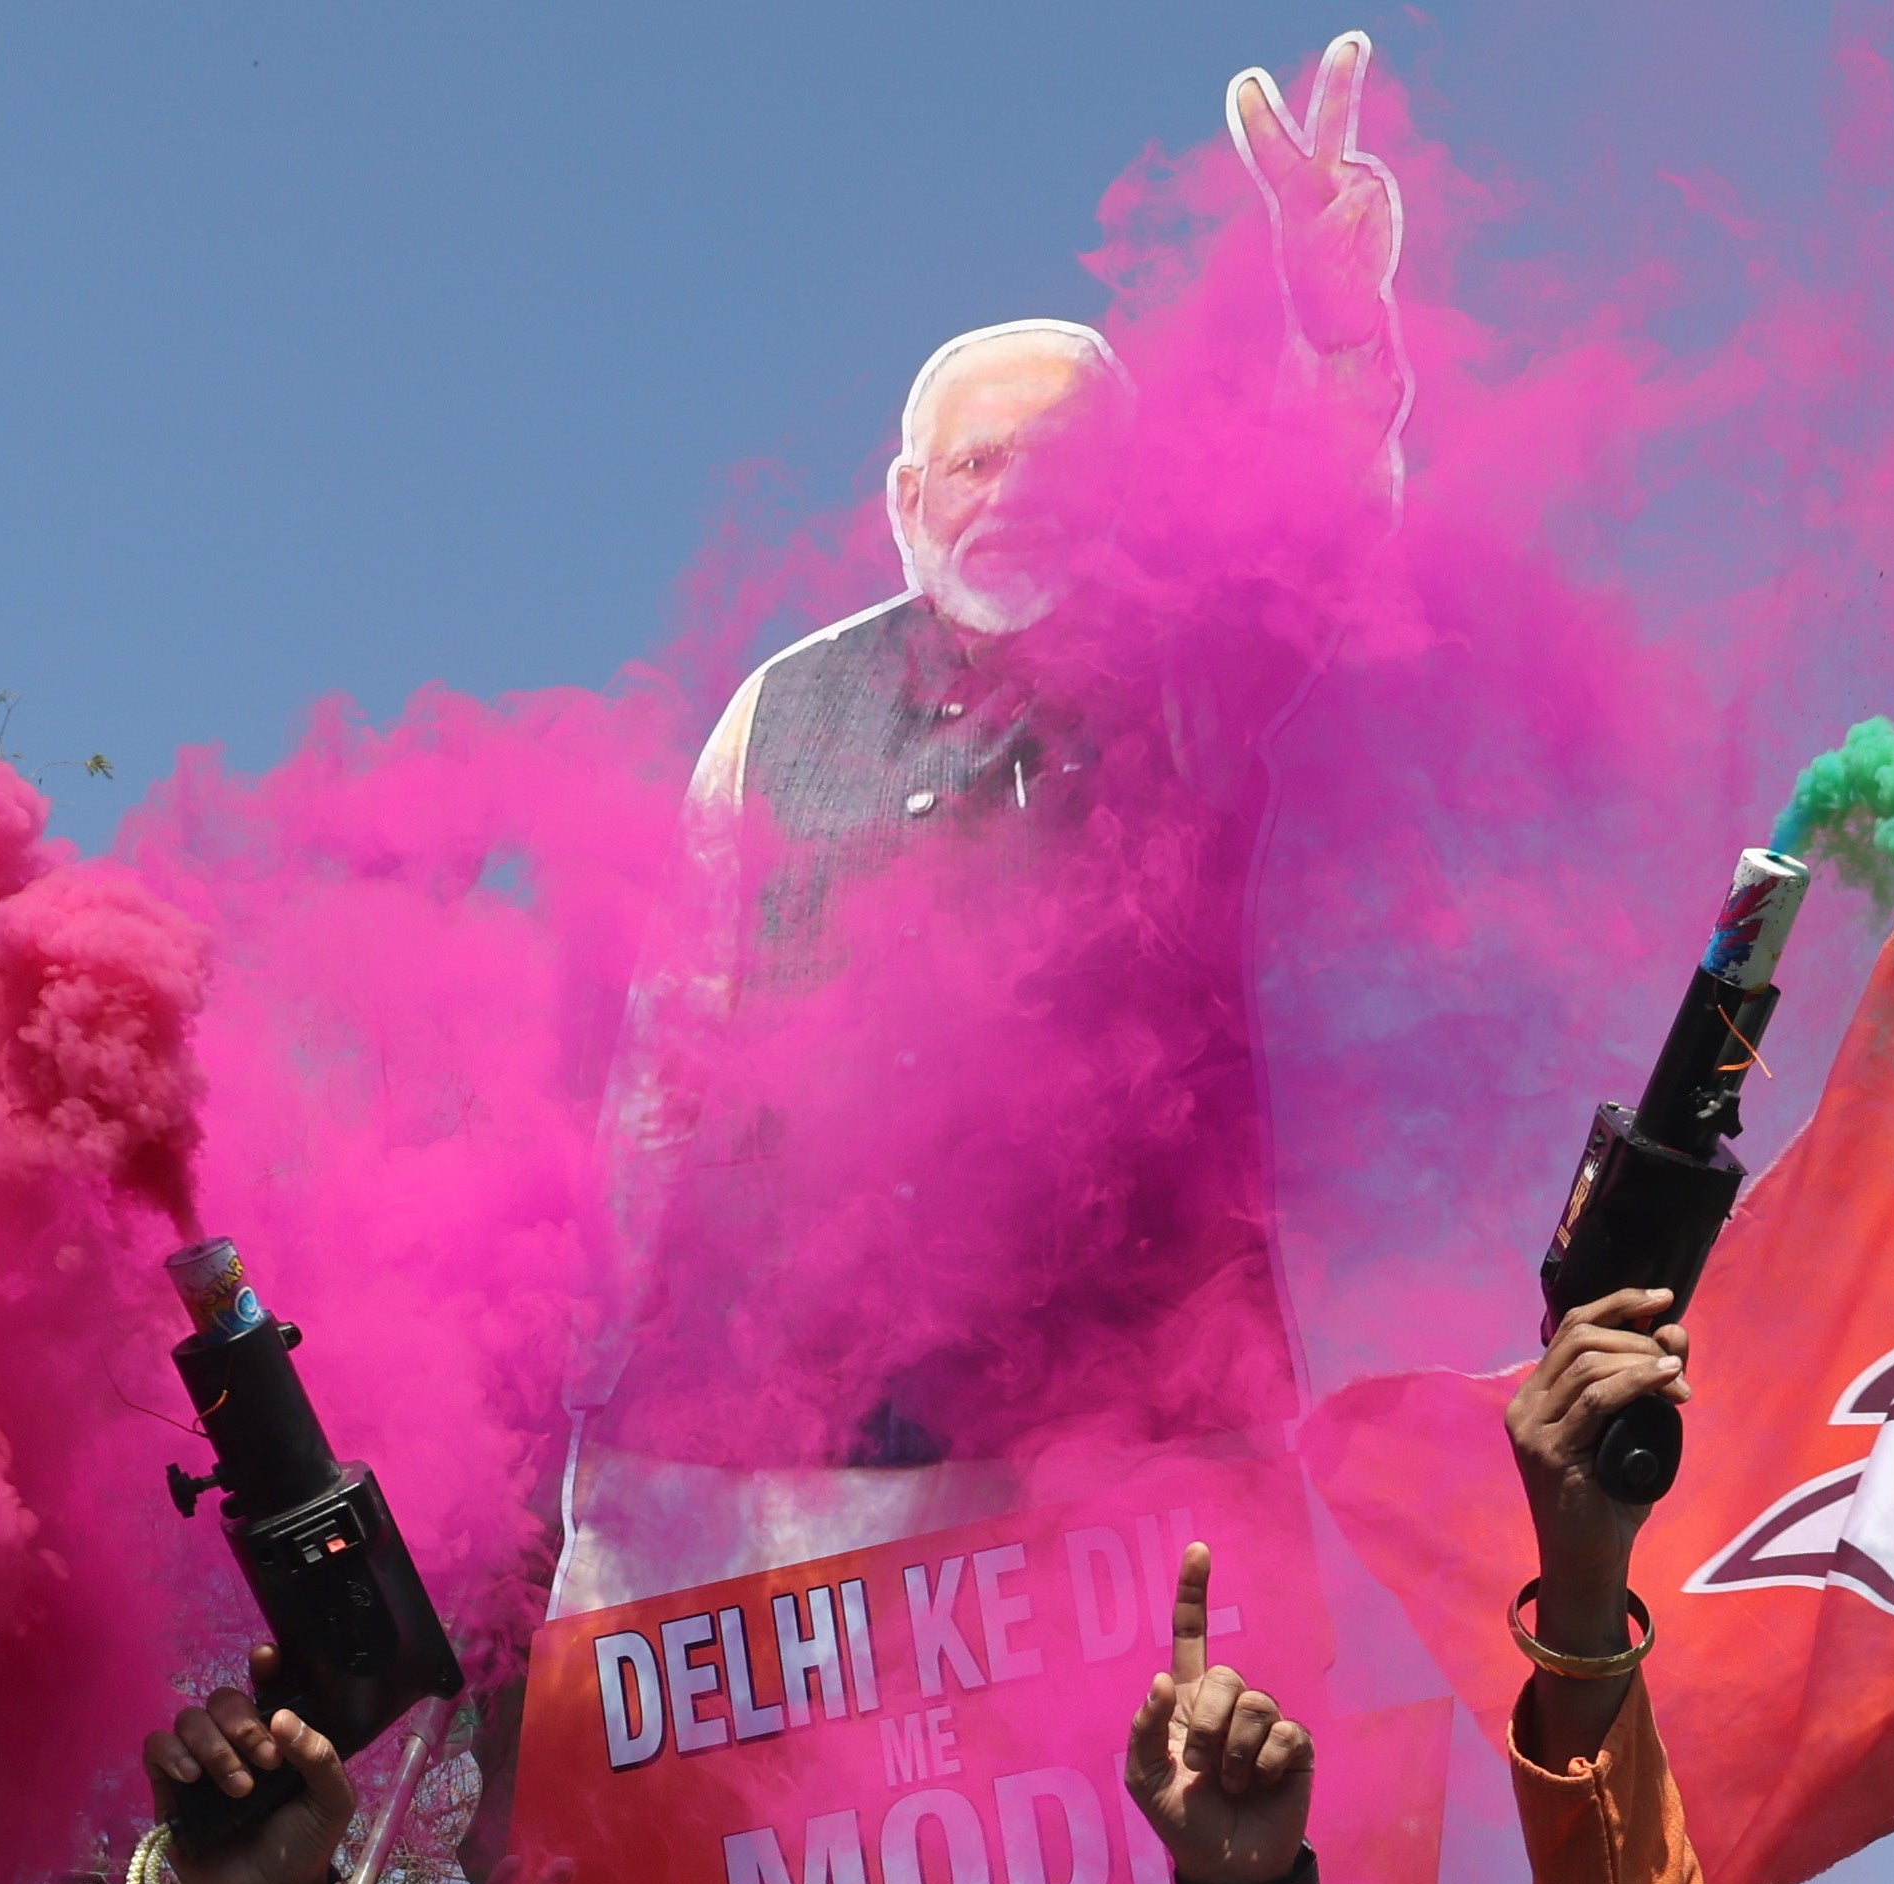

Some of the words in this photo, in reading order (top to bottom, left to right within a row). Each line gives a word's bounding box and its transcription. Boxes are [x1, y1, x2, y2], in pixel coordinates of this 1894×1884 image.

[594, 1578, 879, 1773] DELHI
[904, 1540, 1046, 1702] KE
[878, 1704, 963, 1790] ME
